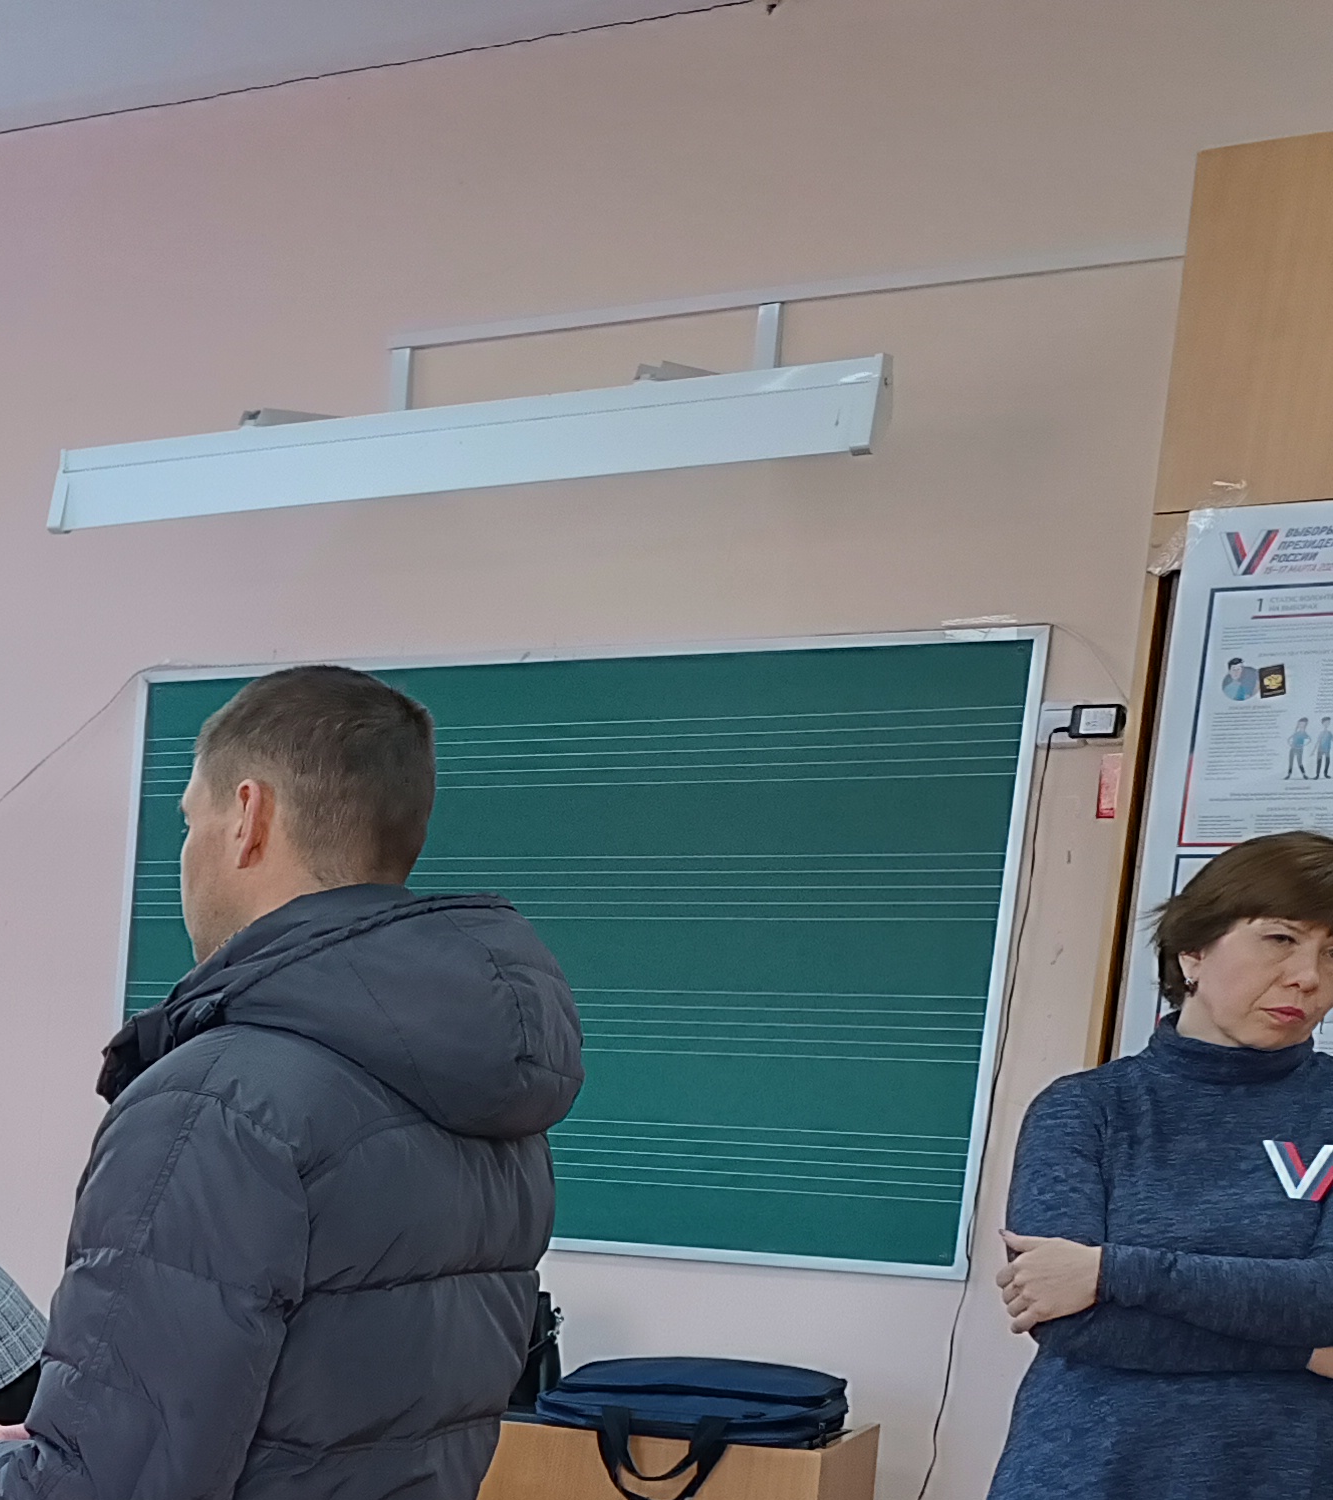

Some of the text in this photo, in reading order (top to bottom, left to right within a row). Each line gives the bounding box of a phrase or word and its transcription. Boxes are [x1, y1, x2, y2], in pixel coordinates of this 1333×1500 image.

[1277, 538, 1333, 551] ПРЕЗИДЕ
[1269, 551, 1319, 563] РОССИИ
[1257, 598, 1264, 612] 1
